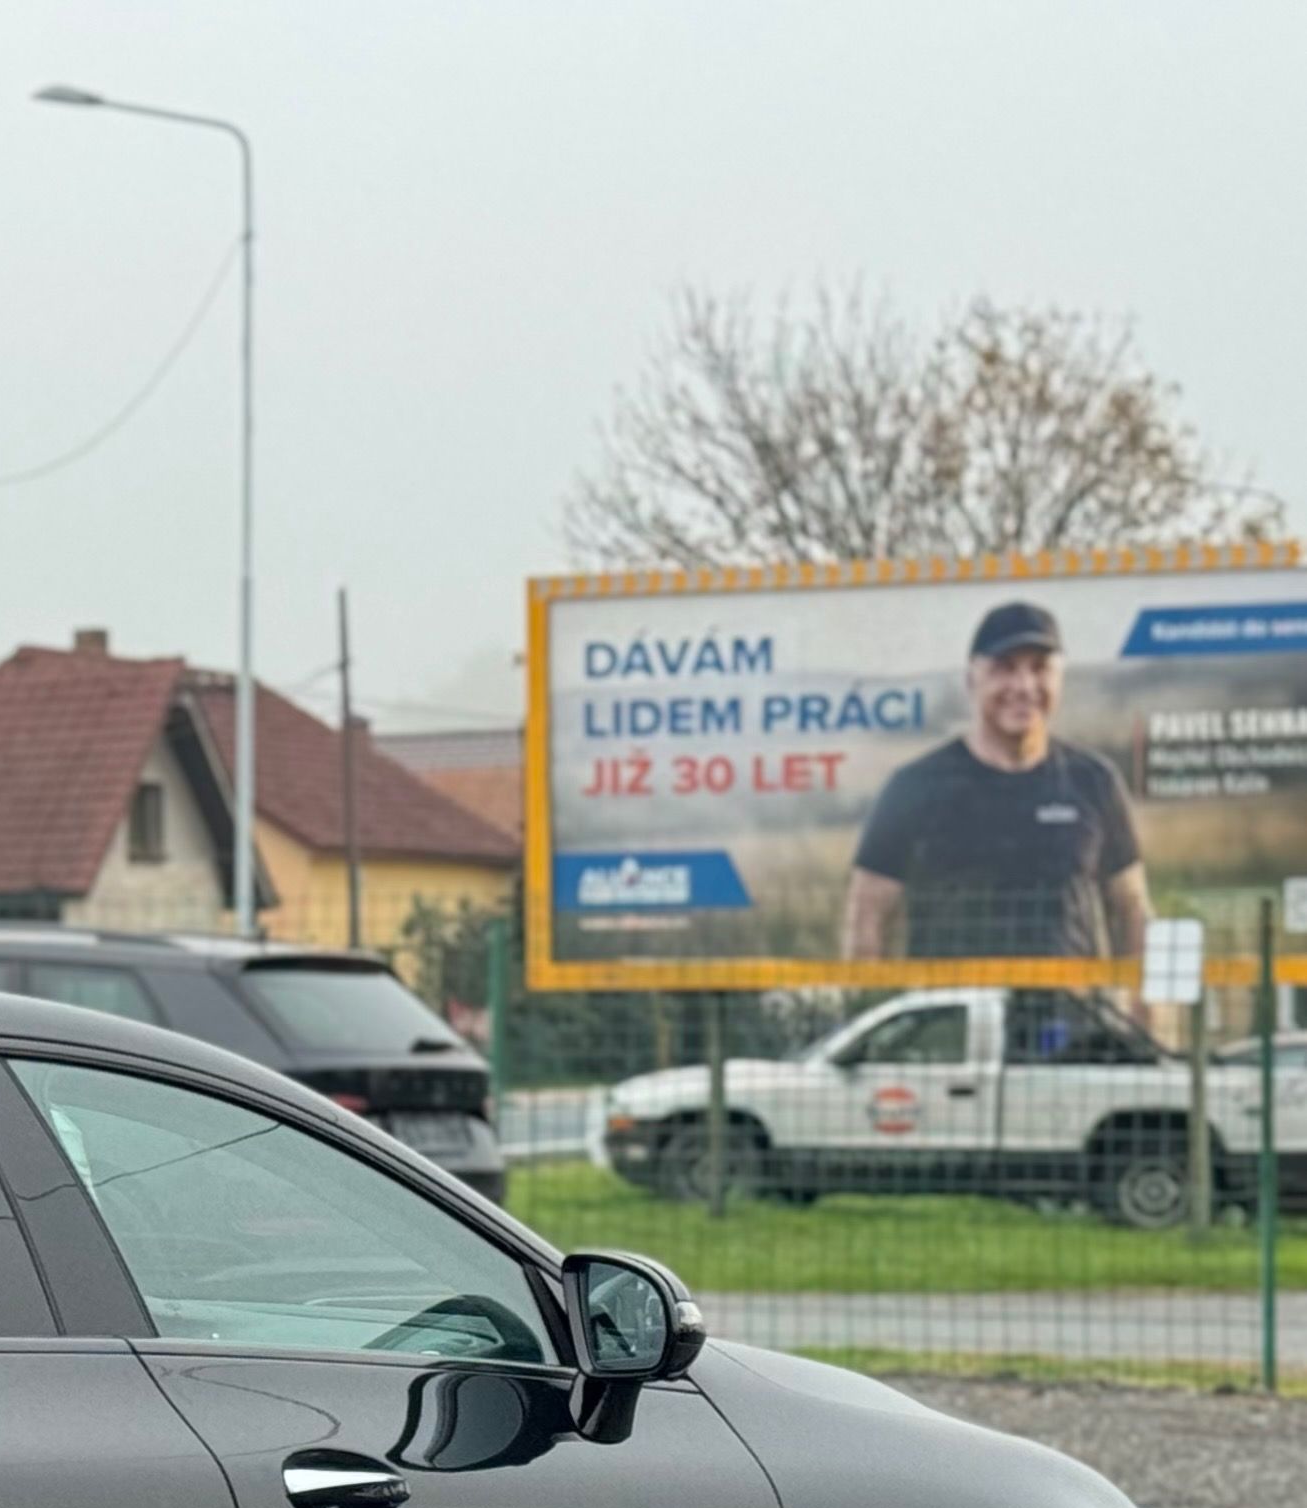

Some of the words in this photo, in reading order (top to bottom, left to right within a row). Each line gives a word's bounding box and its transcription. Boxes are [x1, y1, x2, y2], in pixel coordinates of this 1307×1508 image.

[585, 626, 773, 678] DÁVÁM
[585, 697, 741, 738] LIDEM
[762, 679, 924, 734] PRÁCI
[583, 748, 653, 796] JIŽ
[672, 754, 736, 795] 30
[752, 752, 846, 793] LET
